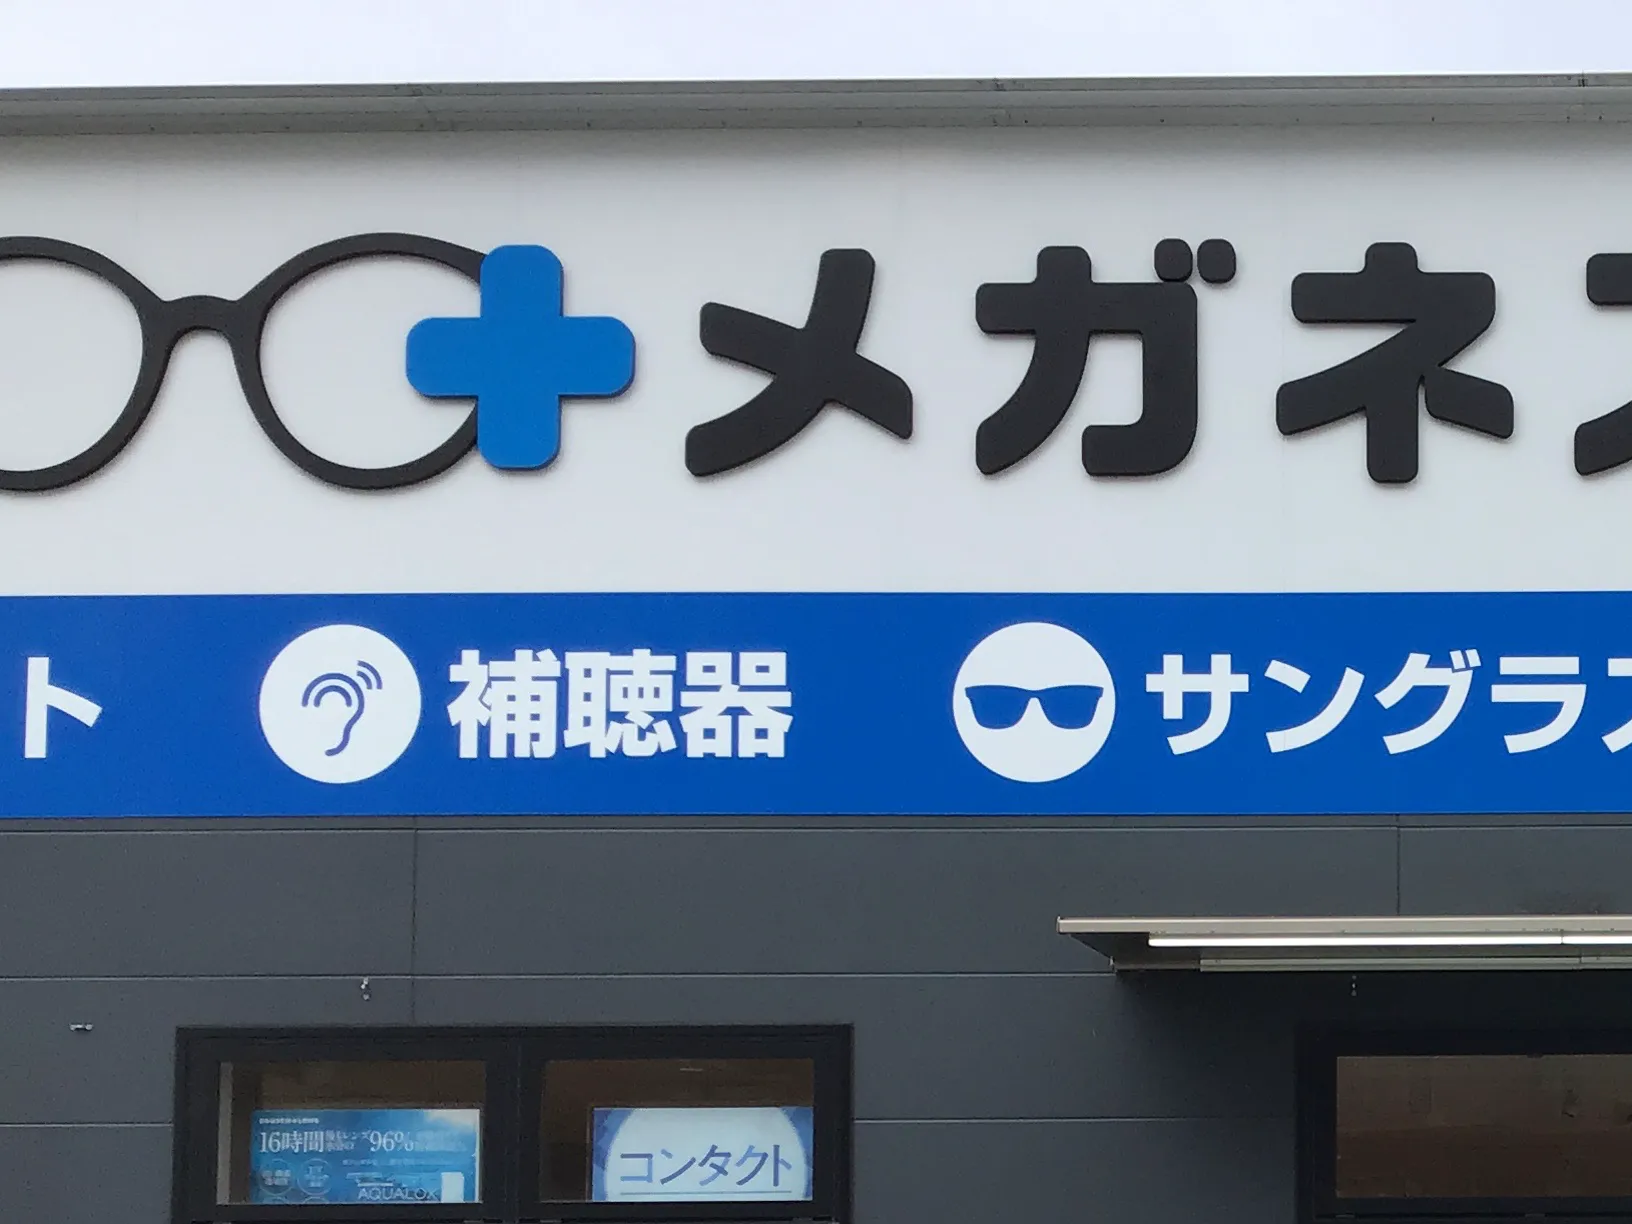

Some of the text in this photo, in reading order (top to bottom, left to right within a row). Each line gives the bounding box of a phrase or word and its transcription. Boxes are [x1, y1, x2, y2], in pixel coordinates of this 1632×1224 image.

[23, 657, 103, 759] ト
[447, 650, 793, 760] 補聴器
[619, 1145, 793, 1187] コンタクト
